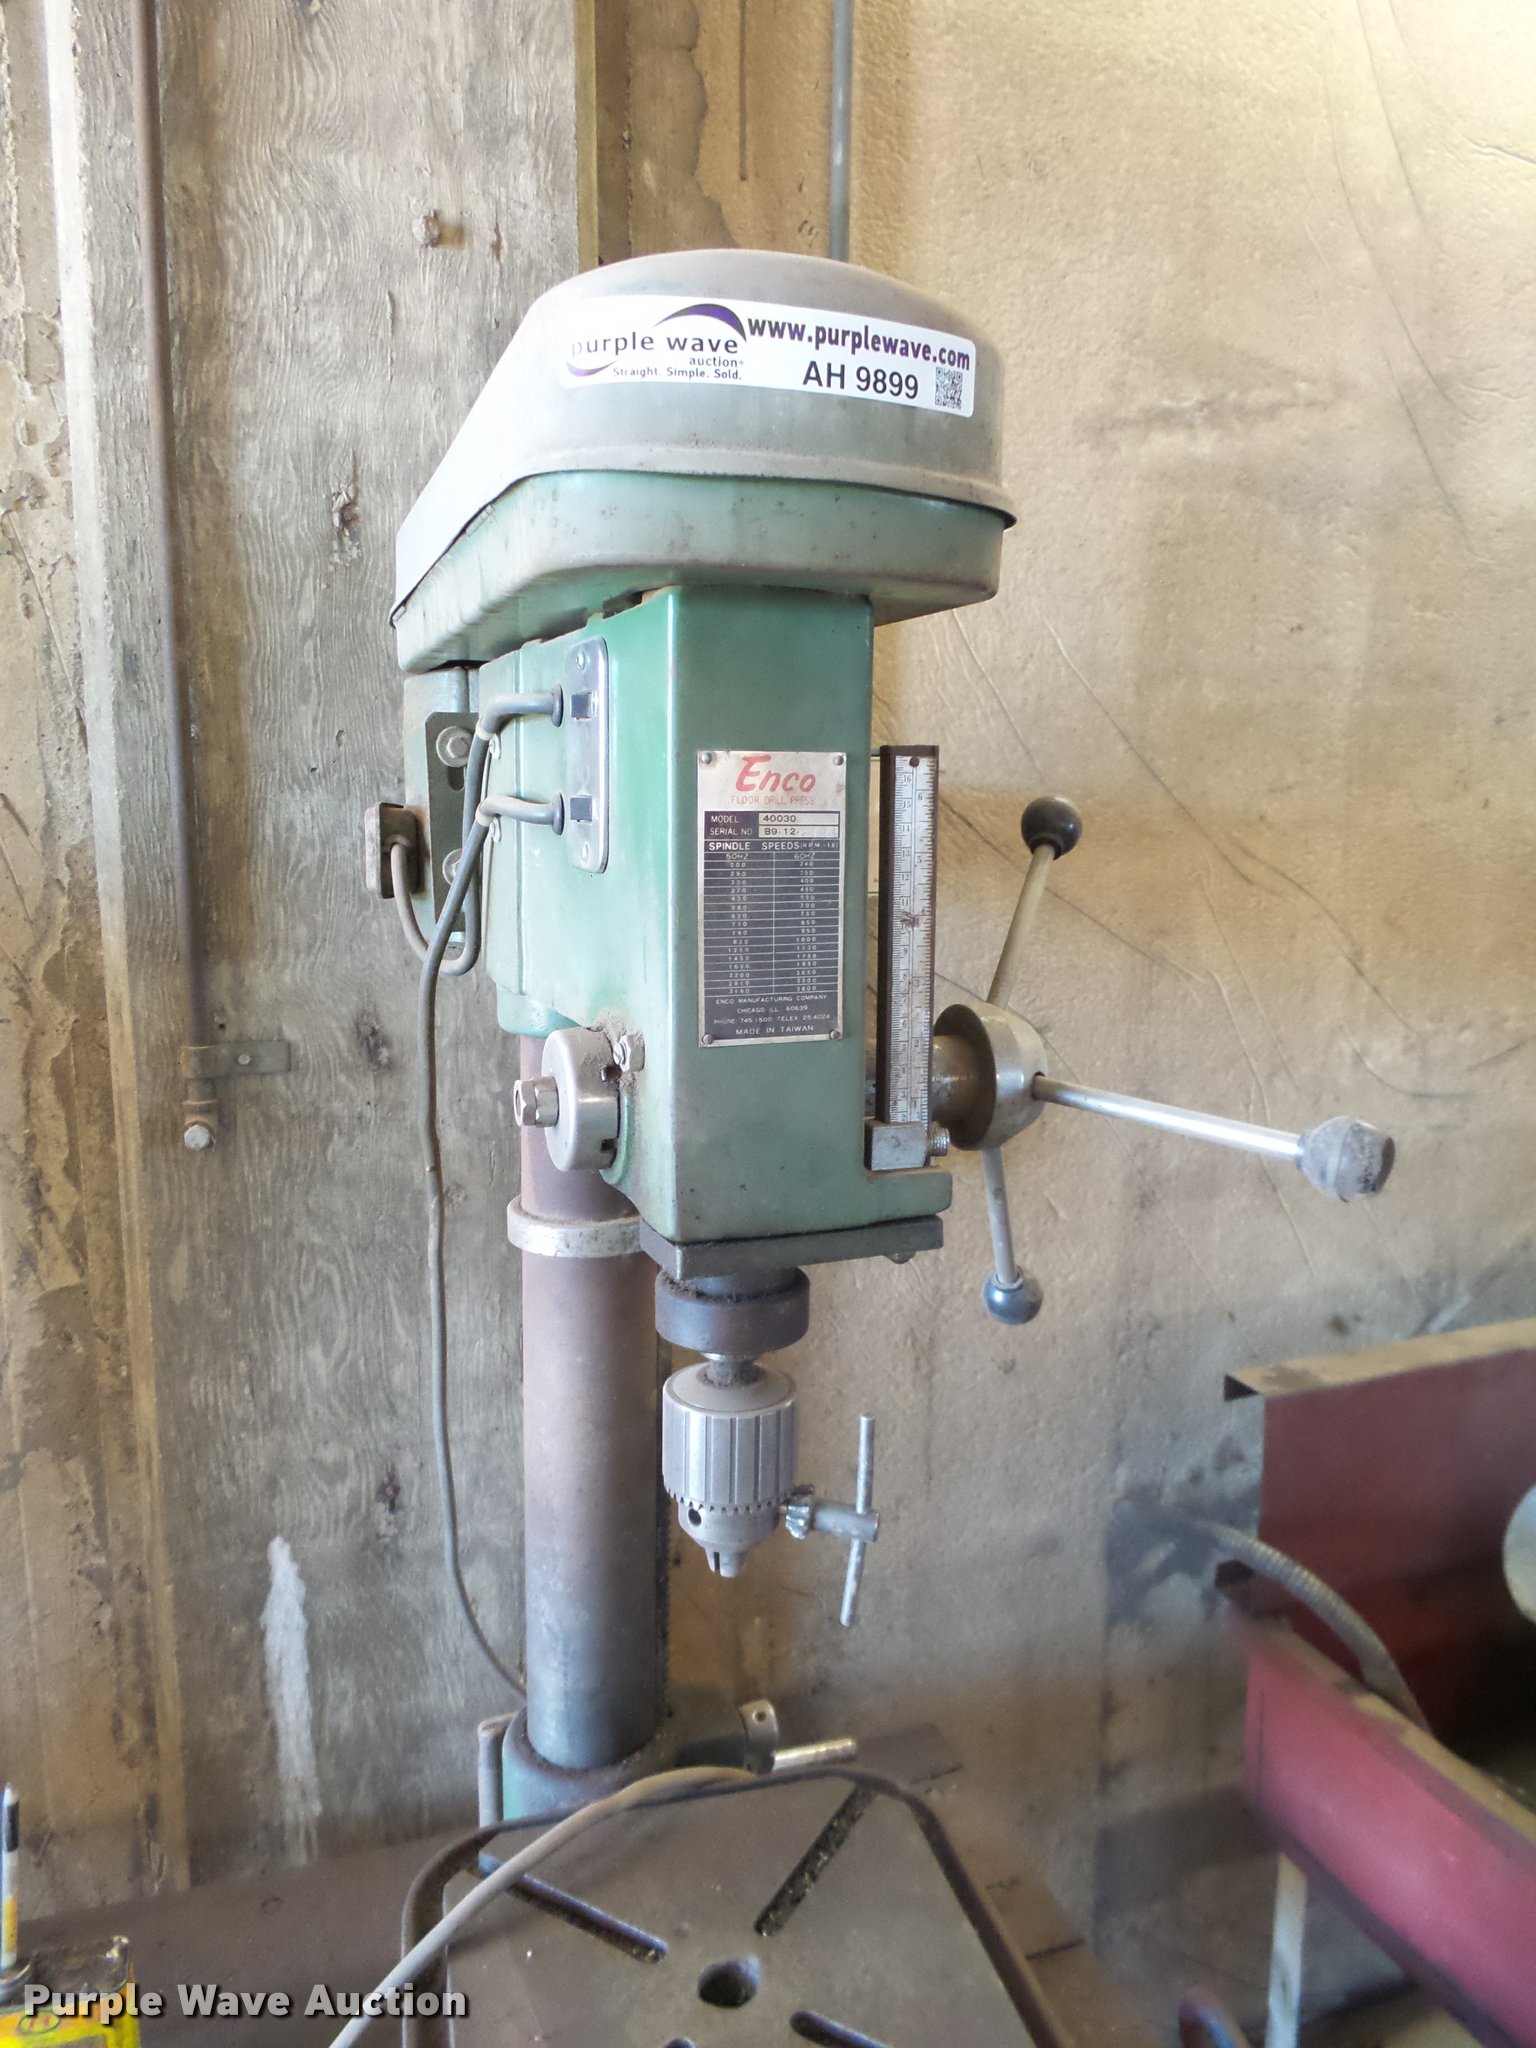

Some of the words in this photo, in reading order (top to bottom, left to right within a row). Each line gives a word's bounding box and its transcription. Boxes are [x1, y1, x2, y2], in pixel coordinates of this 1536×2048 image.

[572, 331, 654, 359] purple
[666, 336, 739, 354] wave
[748, 318, 970, 371] www.purplewave.com
[689, 356, 738, 367] auction
[613, 367, 661, 378] Straight.
[667, 368, 710, 379] Simple.
[714, 369, 742, 380] Sold.
[802, 361, 846, 389] AH
[856, 366, 919, 399] 9899
[736, 754, 816, 793] Enco
[731, 795, 759, 804] FLOOR
[764, 795, 787, 805] DRILL
[790, 795, 815, 805] PRESS
[711, 815, 739, 823] MODEL
[763, 814, 796, 822] 40030
[710, 827, 738, 836] SERIAL
[709, 841, 751, 851] SPINDLE
[762, 841, 800, 850] SPEEDS
[780, 1024, 814, 1033] TAIWAN
